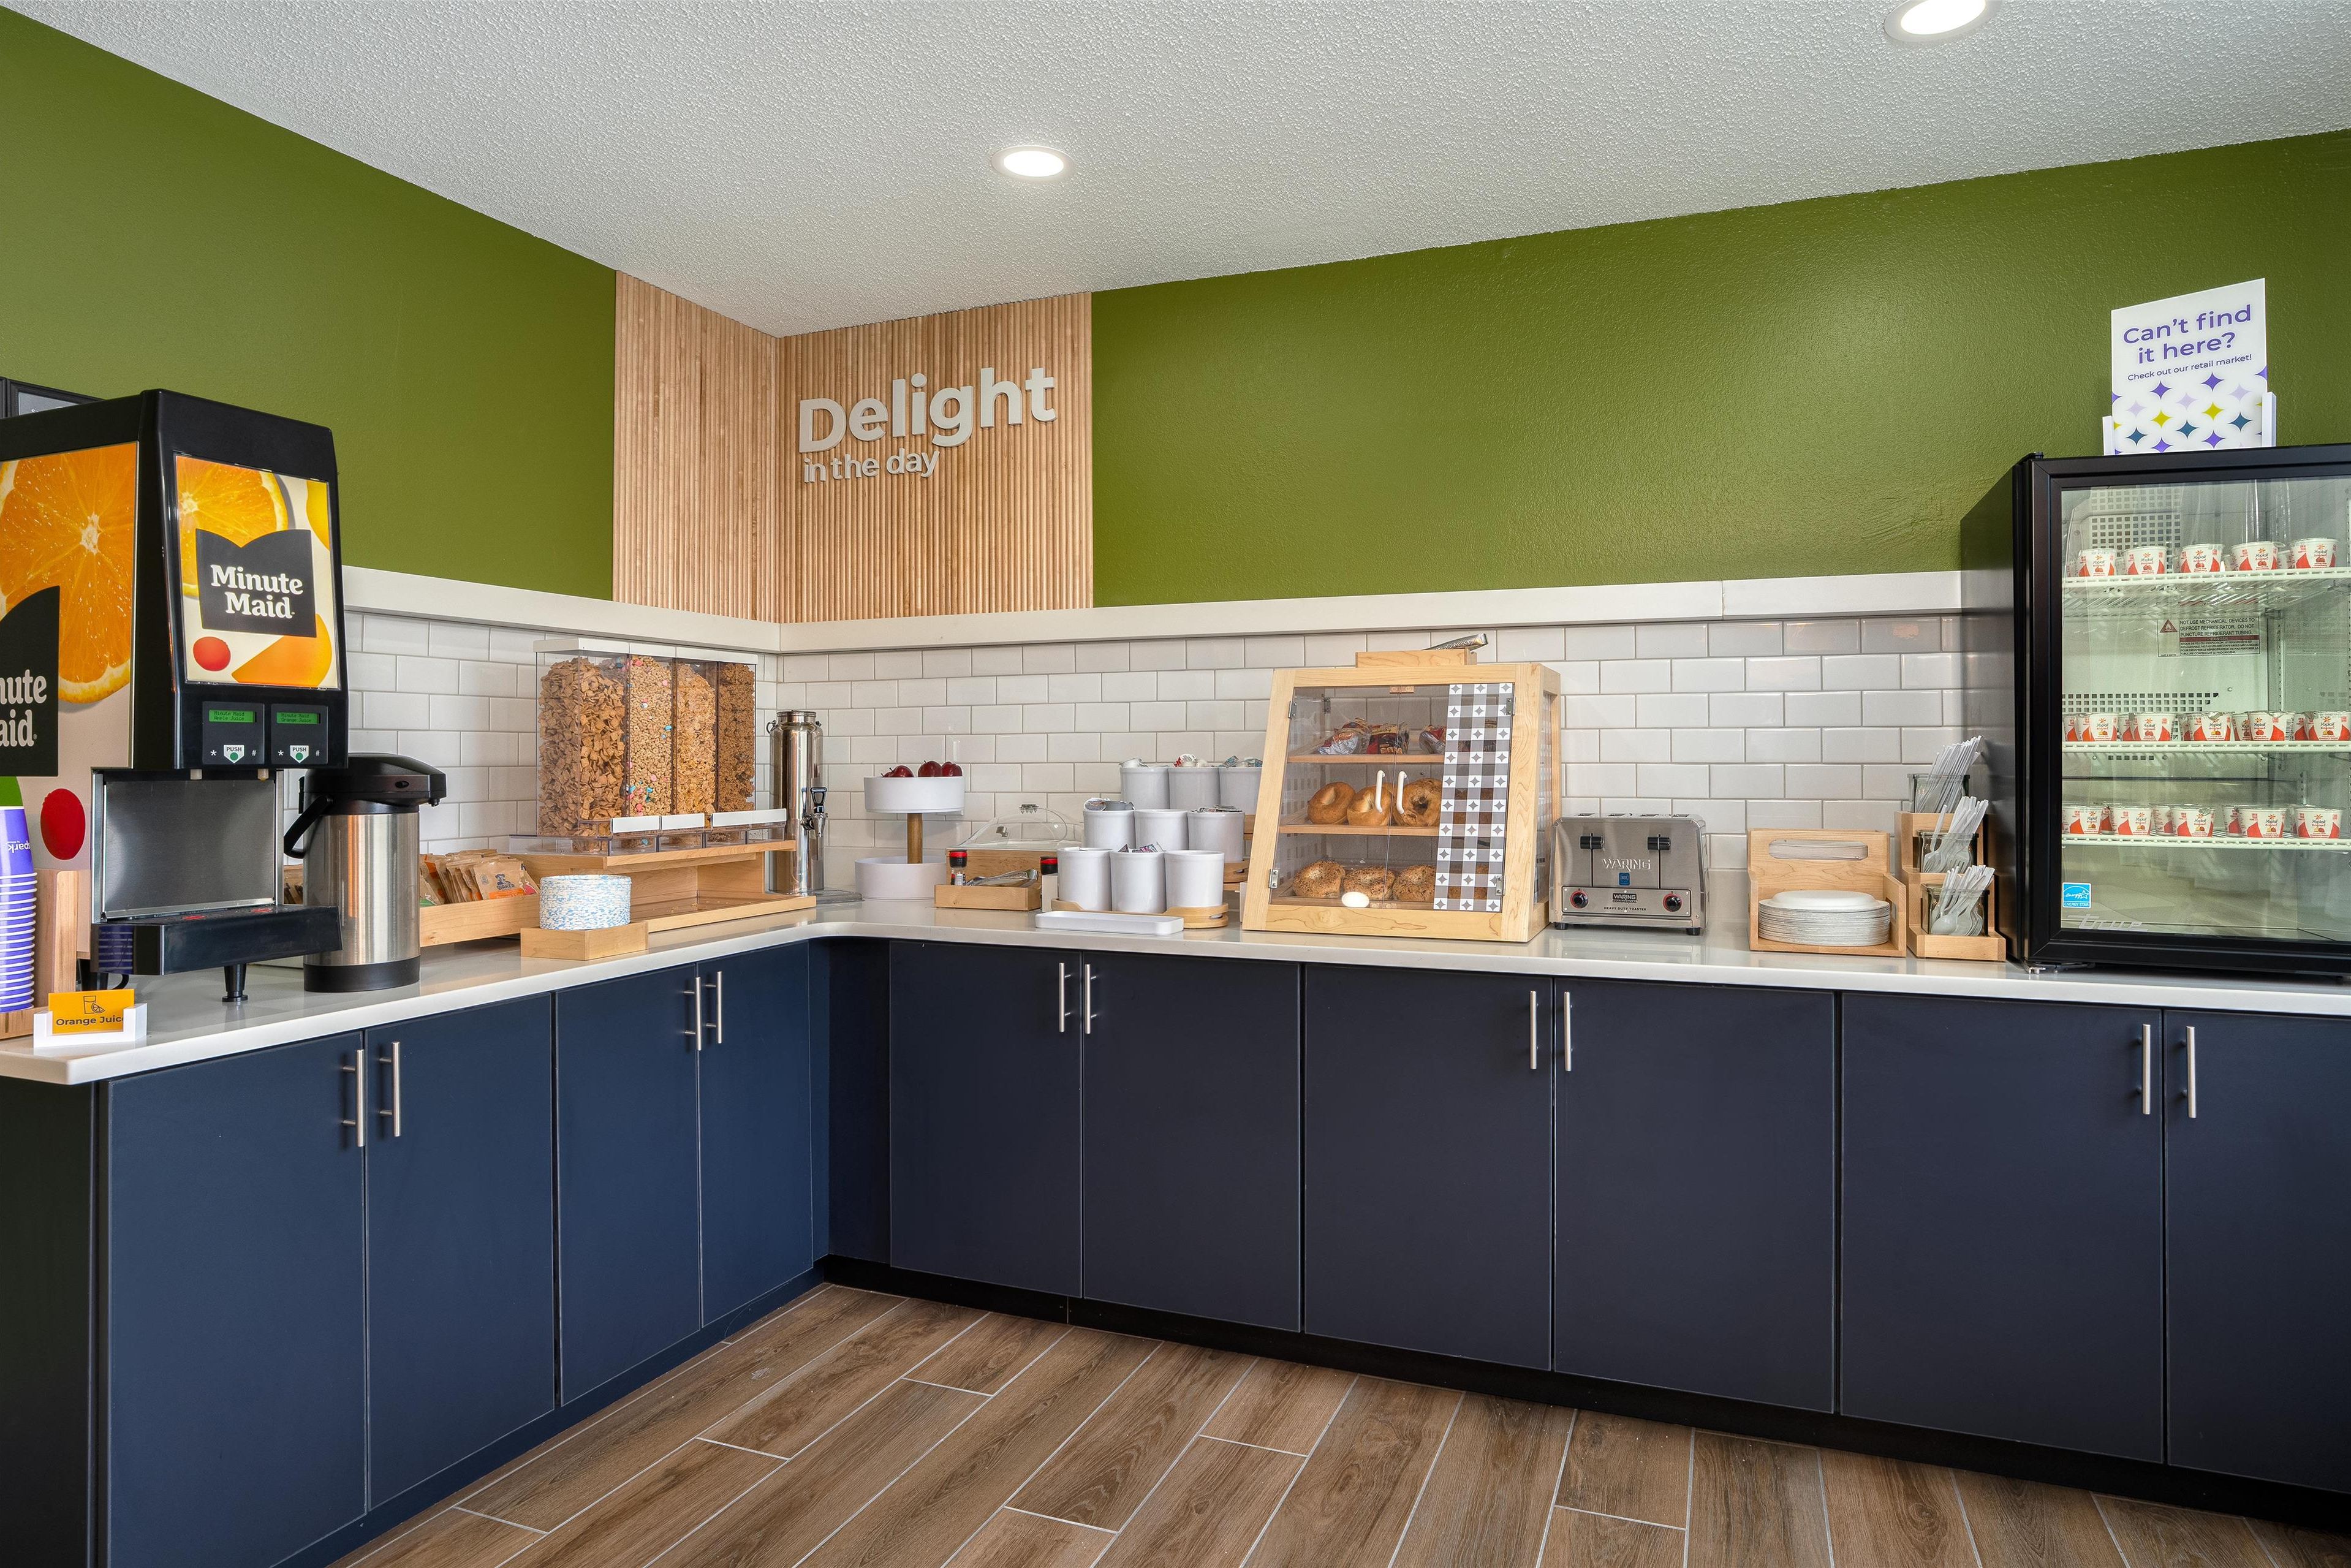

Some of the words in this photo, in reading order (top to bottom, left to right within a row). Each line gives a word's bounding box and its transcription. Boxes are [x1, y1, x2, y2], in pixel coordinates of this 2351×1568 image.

[2124, 318, 2189, 344] Can't
[2197, 304, 2252, 331] find
[2138, 346, 2154, 364] it
[2164, 331, 2236, 360] here?
[2127, 371, 2155, 381] Check
[2191, 360, 2213, 370] retail
[2216, 354, 2252, 367] market!
[798, 367, 1058, 453] Delight
[804, 458, 826, 483] in
[831, 453, 880, 480] the
[886, 447, 940, 478] day
[211, 564, 303, 595] Minute
[224, 592, 293, 619] Maid
[1603, 858, 1651, 872] WARING
